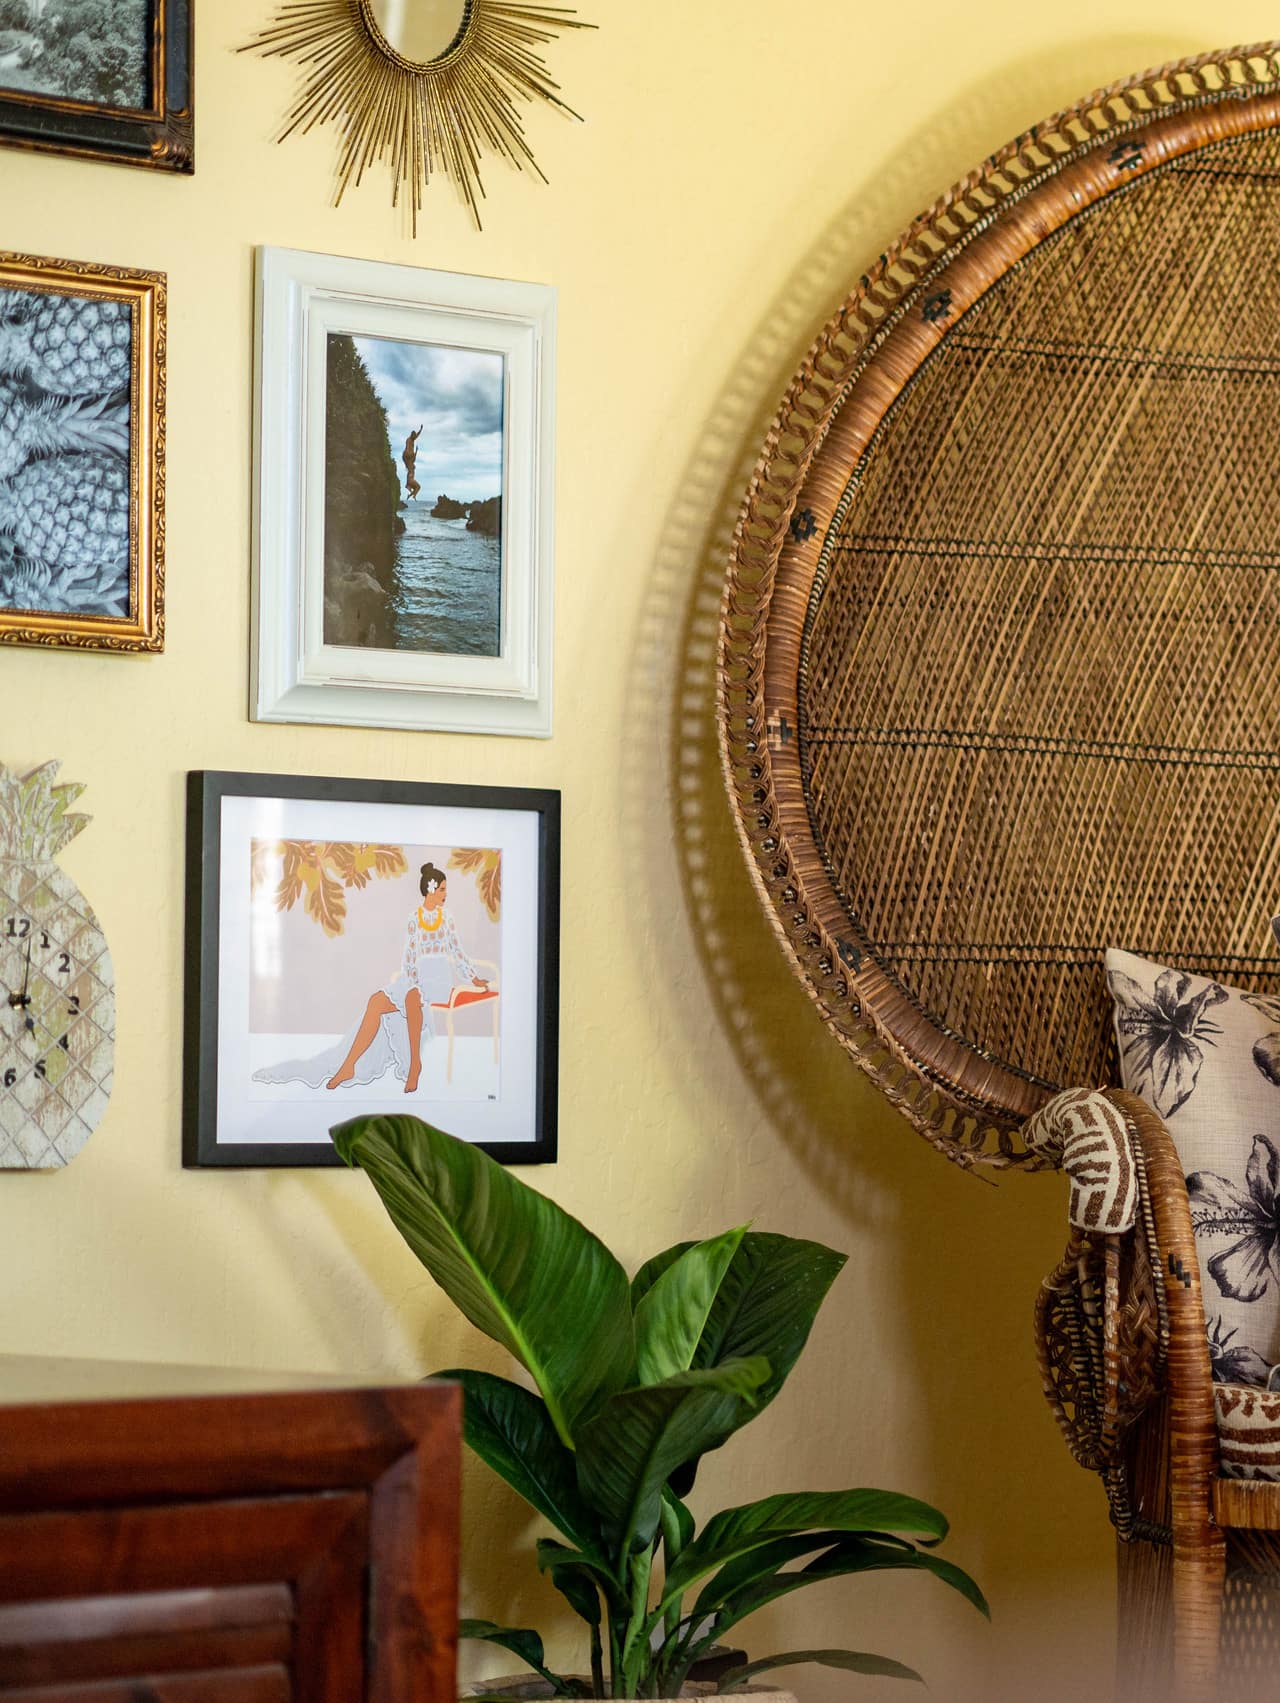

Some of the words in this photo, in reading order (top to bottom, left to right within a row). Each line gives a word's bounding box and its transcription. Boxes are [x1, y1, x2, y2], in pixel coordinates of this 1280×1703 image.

[6, 918, 31, 937] 12
[40, 929, 50, 949] 1
[58, 953, 71, 972] 2
[67, 995, 80, 1015] 3
[57, 1033, 69, 1050] 4
[4, 1068, 16, 1087] 6
[34, 1060, 47, 1079] 5
